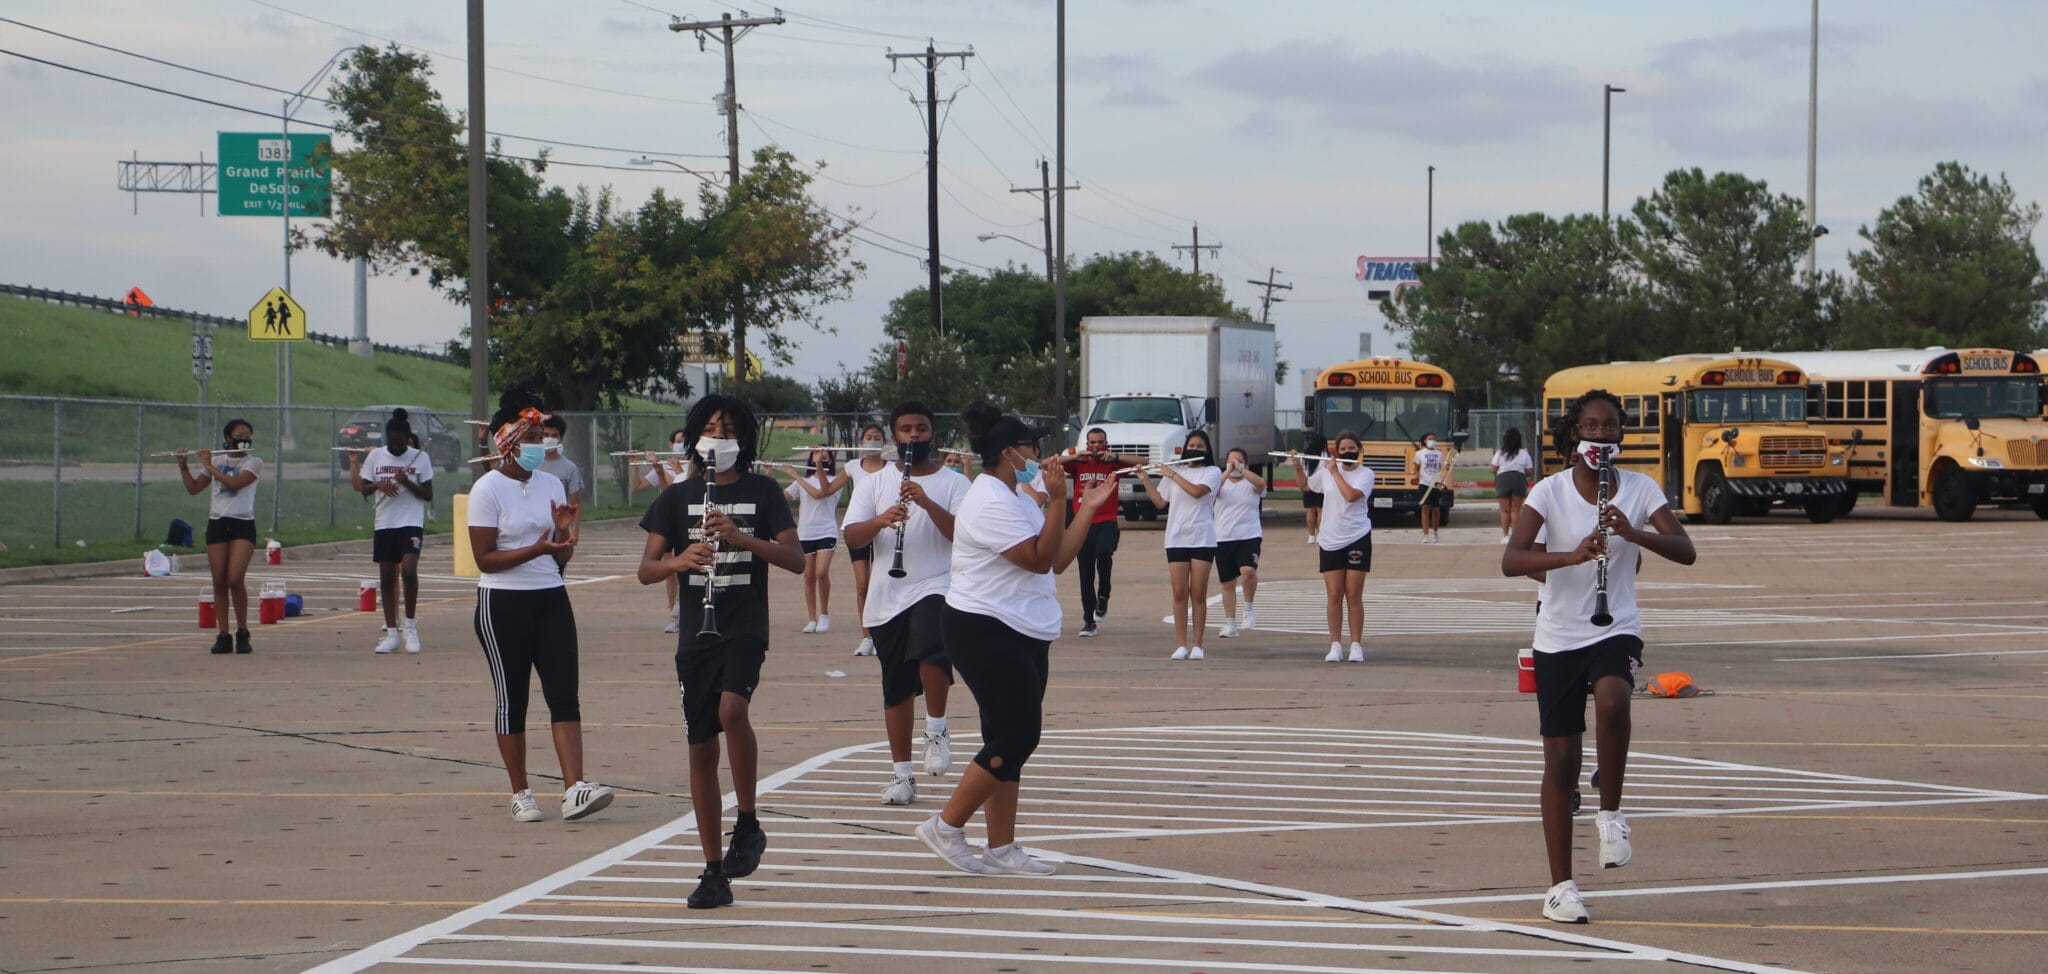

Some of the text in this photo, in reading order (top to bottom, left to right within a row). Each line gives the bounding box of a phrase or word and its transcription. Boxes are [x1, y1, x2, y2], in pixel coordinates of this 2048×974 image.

[226, 167, 269, 178] Grand
[249, 183, 300, 194] DeSoto
[243, 200, 263, 209] EXIT
[678, 335, 703, 343] Ceda
[1964, 357, 2008, 369] SCHOOL BUS
[1359, 371, 1412, 384] SCHOOL BUS
[1725, 369, 1774, 381] SCHOOL BUS
[375, 466, 417, 475] LONGHN
